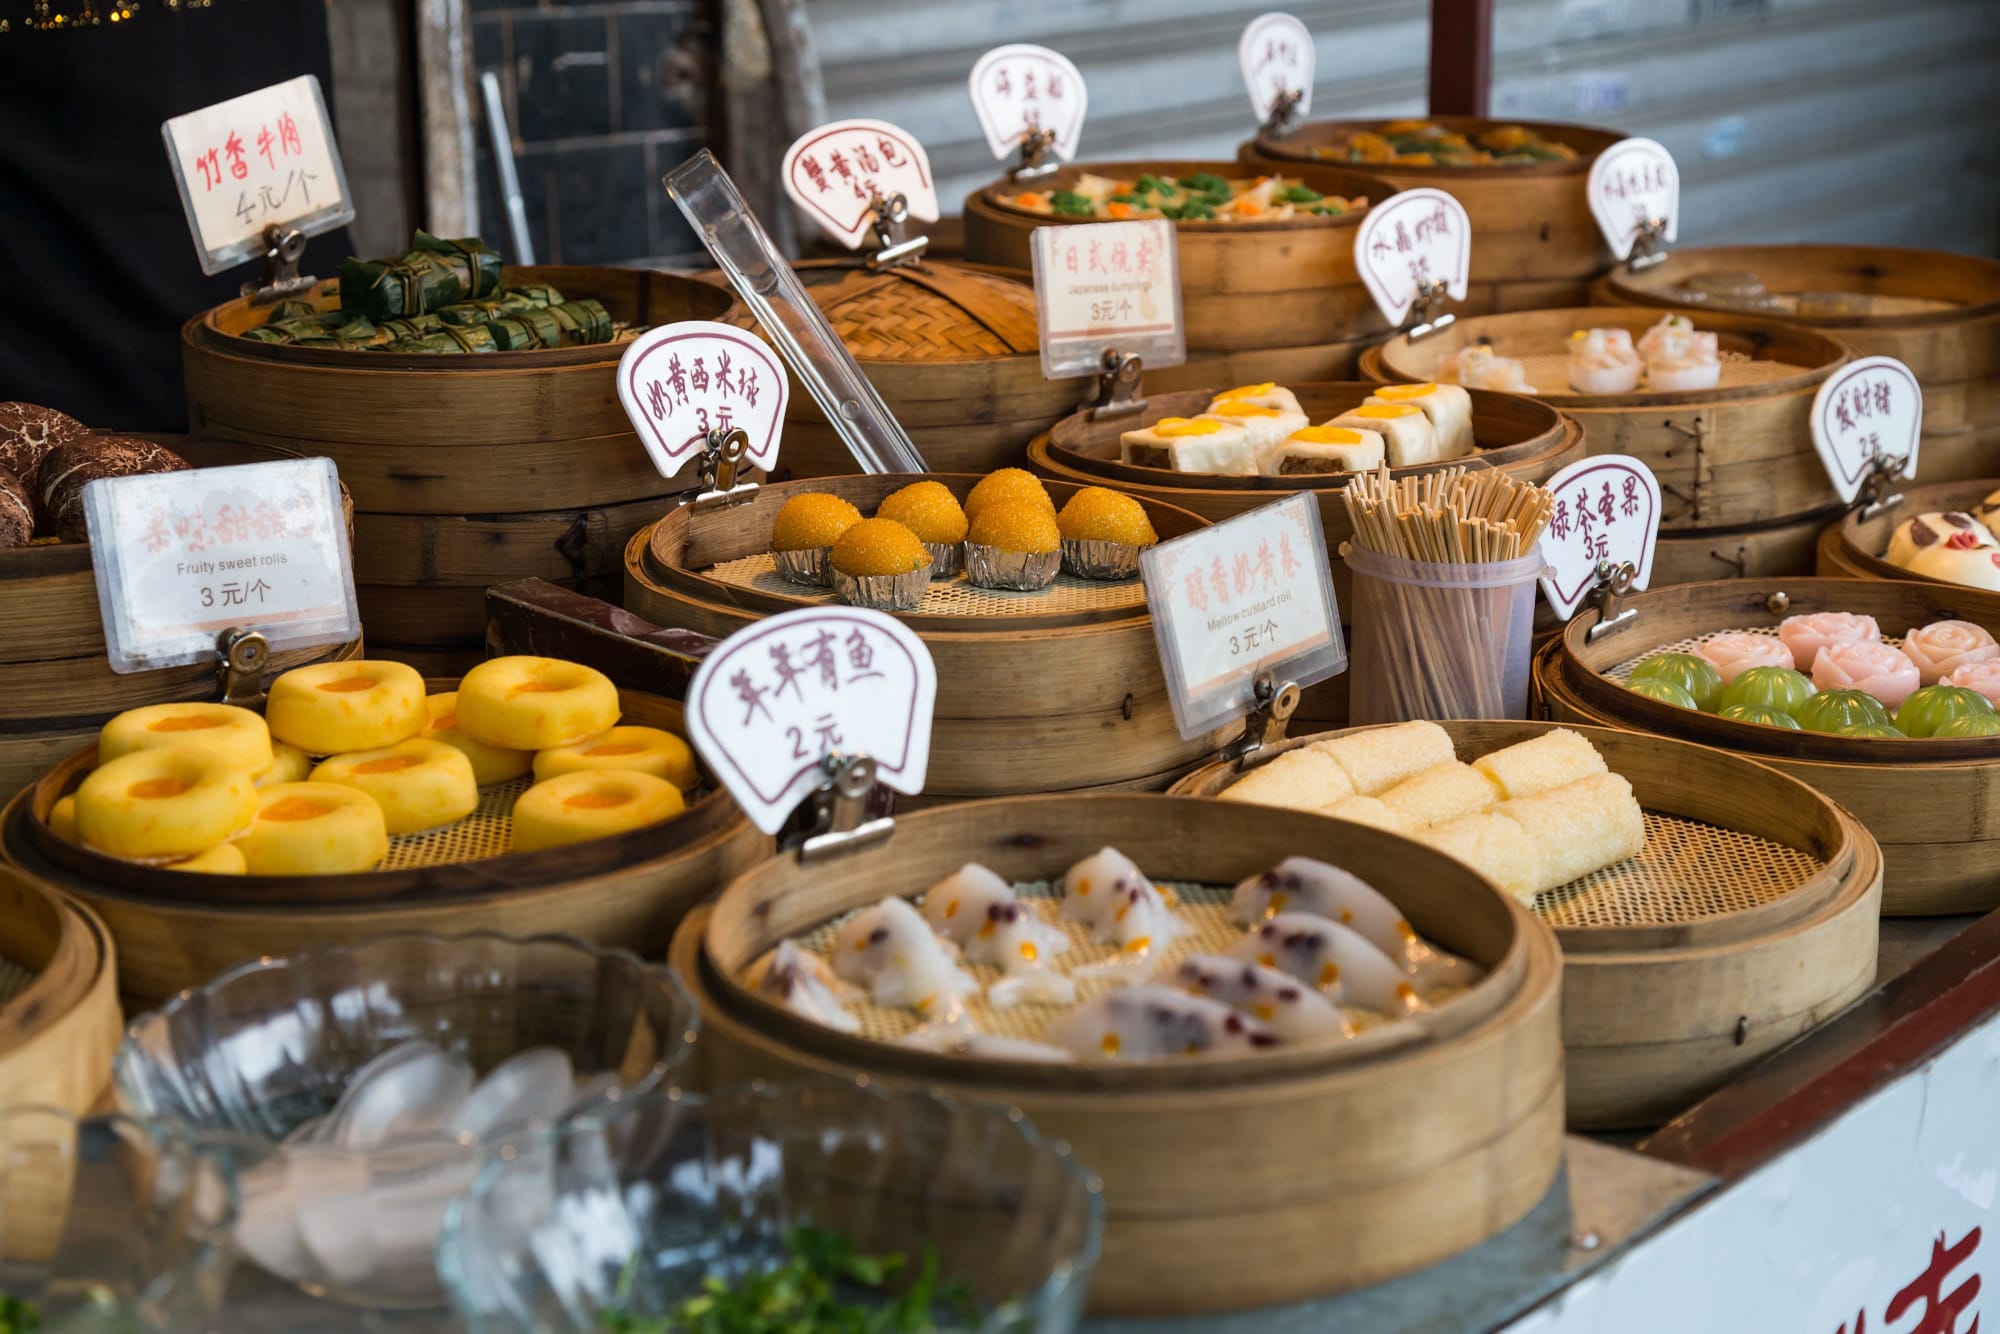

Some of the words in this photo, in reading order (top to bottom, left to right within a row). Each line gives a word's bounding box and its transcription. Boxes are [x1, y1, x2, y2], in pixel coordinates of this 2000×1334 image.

[196, 111, 302, 191] 竹香牛肉
[236, 169, 317, 224] 4元/个
[1091, 298, 1133, 321] 3元/个
[646, 349, 760, 421] 奶黄西米球
[177, 560, 215, 576] Fruity
[218, 556, 257, 571] sweet
[260, 553, 288, 566] rolls
[1584, 534, 1609, 561] 3元
[1207, 613, 1240, 633] Mellow
[1241, 598, 1276, 619] custard
[786, 714, 843, 760] 2元
